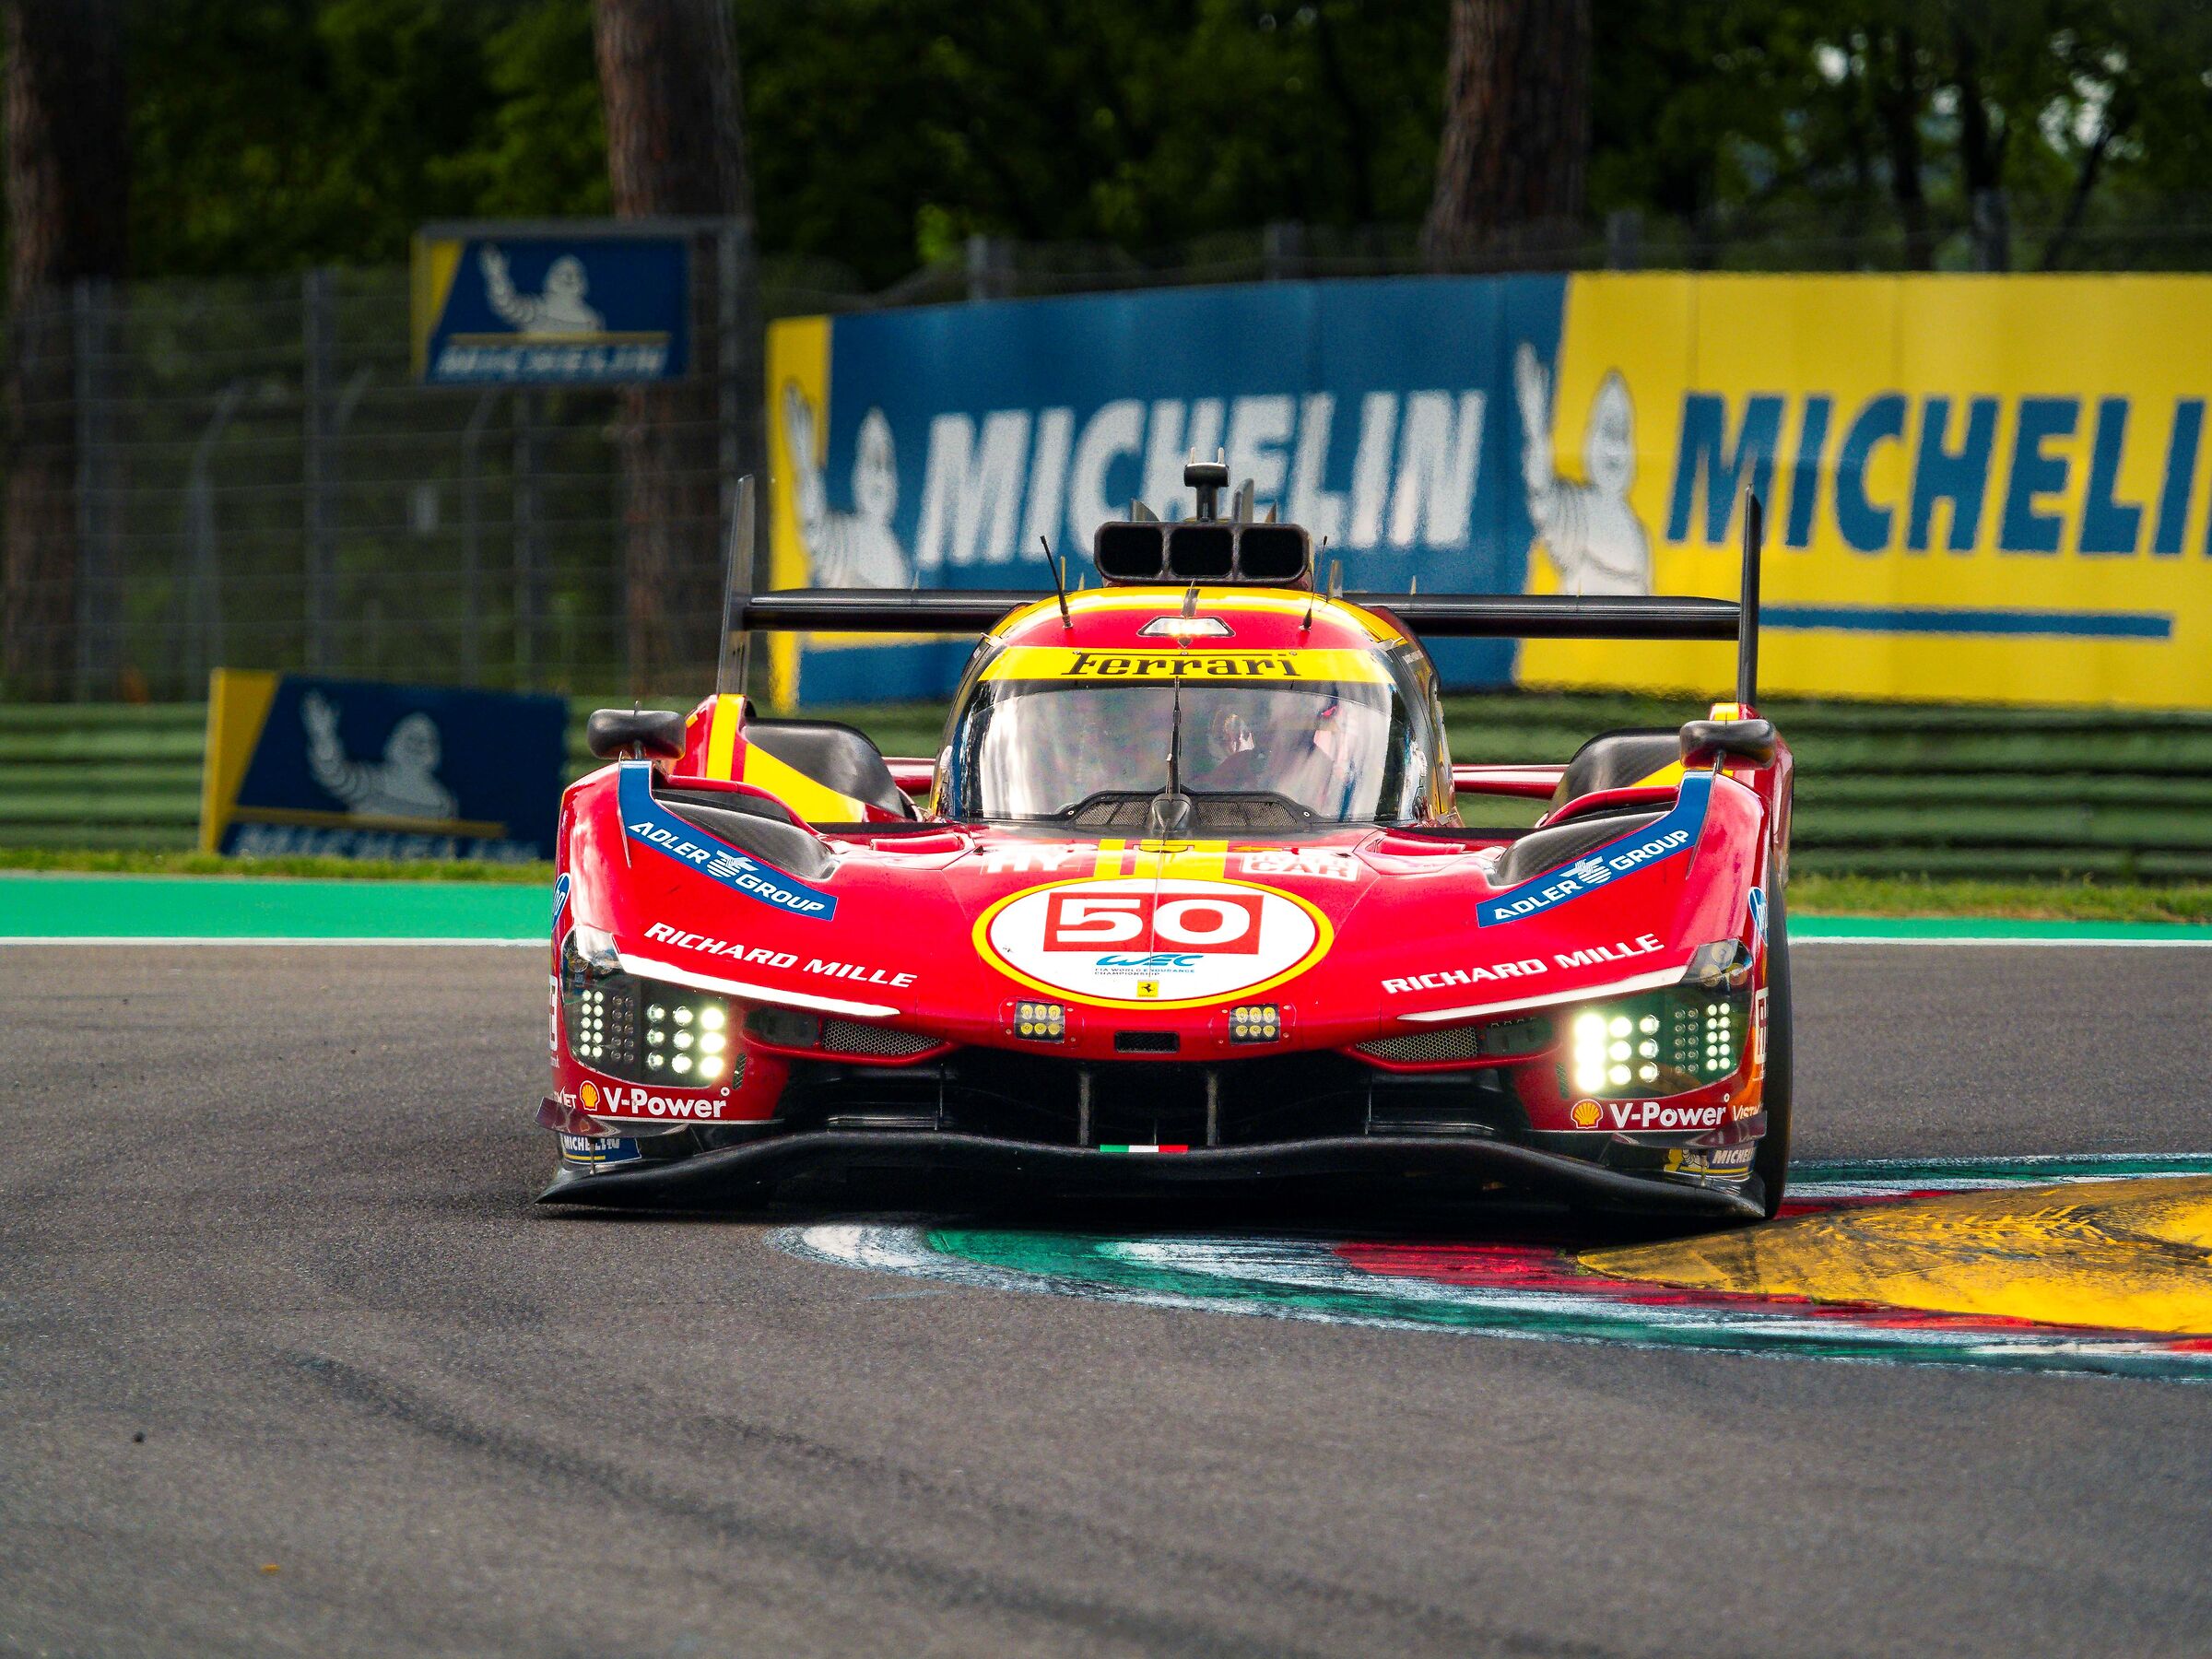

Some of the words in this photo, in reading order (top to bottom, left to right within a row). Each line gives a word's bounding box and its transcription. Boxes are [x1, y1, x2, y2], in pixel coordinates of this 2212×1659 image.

[914, 388, 1487, 570] MICHELIN
[1665, 392, 2212, 555] MICHELI
[1061, 651, 1301, 677] Ferrari
[629, 820, 712, 865] ADLER
[735, 872, 826, 913] GROUP
[1494, 877, 1583, 921] ADLER
[1608, 829, 1690, 871] GROUP
[1056, 899, 1251, 945] 50
[643, 922, 799, 970] RICHARD
[803, 958, 918, 988] MILLE
[1096, 954, 1205, 967] WEC
[1381, 951, 1548, 994] RICHARD
[1553, 933, 1665, 971] MILLE
[602, 1087, 727, 1118] V-Power
[1609, 1102, 1726, 1130] V-Power
